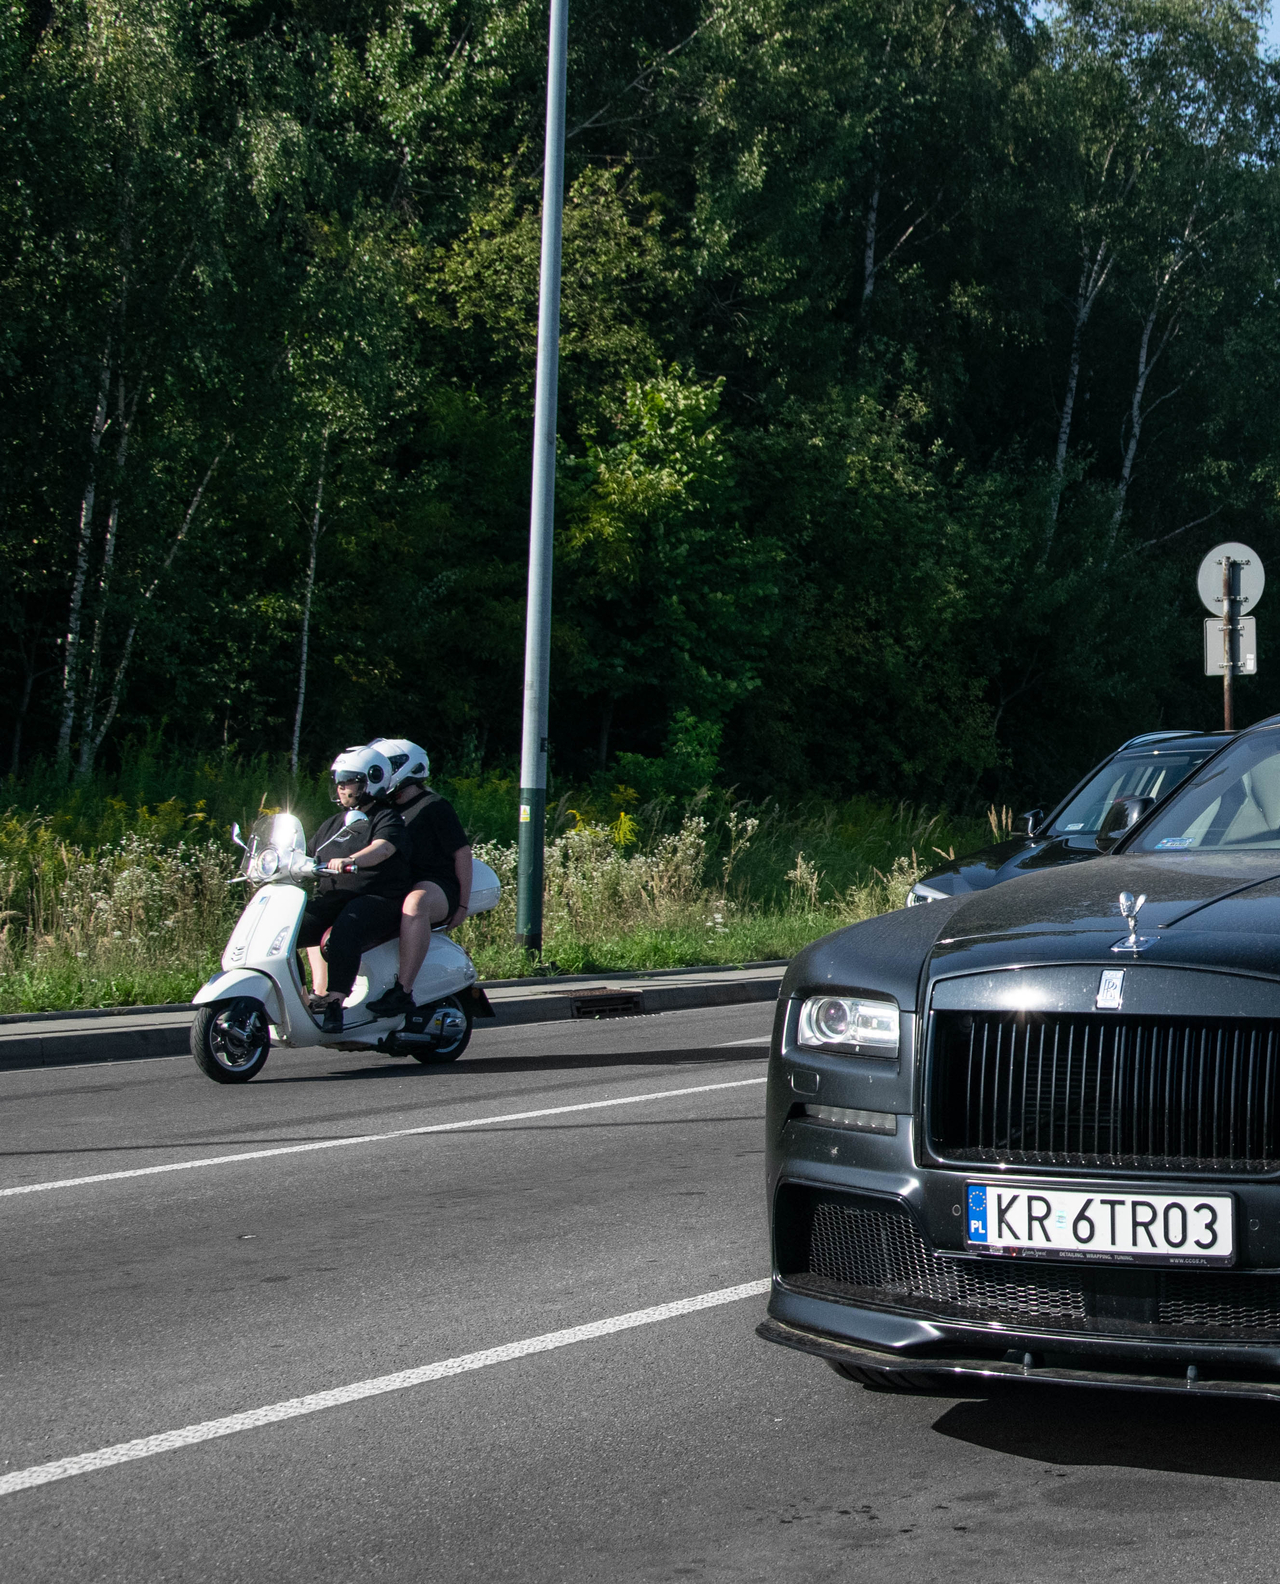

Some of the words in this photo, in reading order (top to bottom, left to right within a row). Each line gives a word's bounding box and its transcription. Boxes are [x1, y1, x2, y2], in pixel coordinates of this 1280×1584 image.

[970, 1220, 985, 1234] PL
[997, 1193, 1052, 1242] KR
[1072, 1198, 1218, 1250] 6TR03
